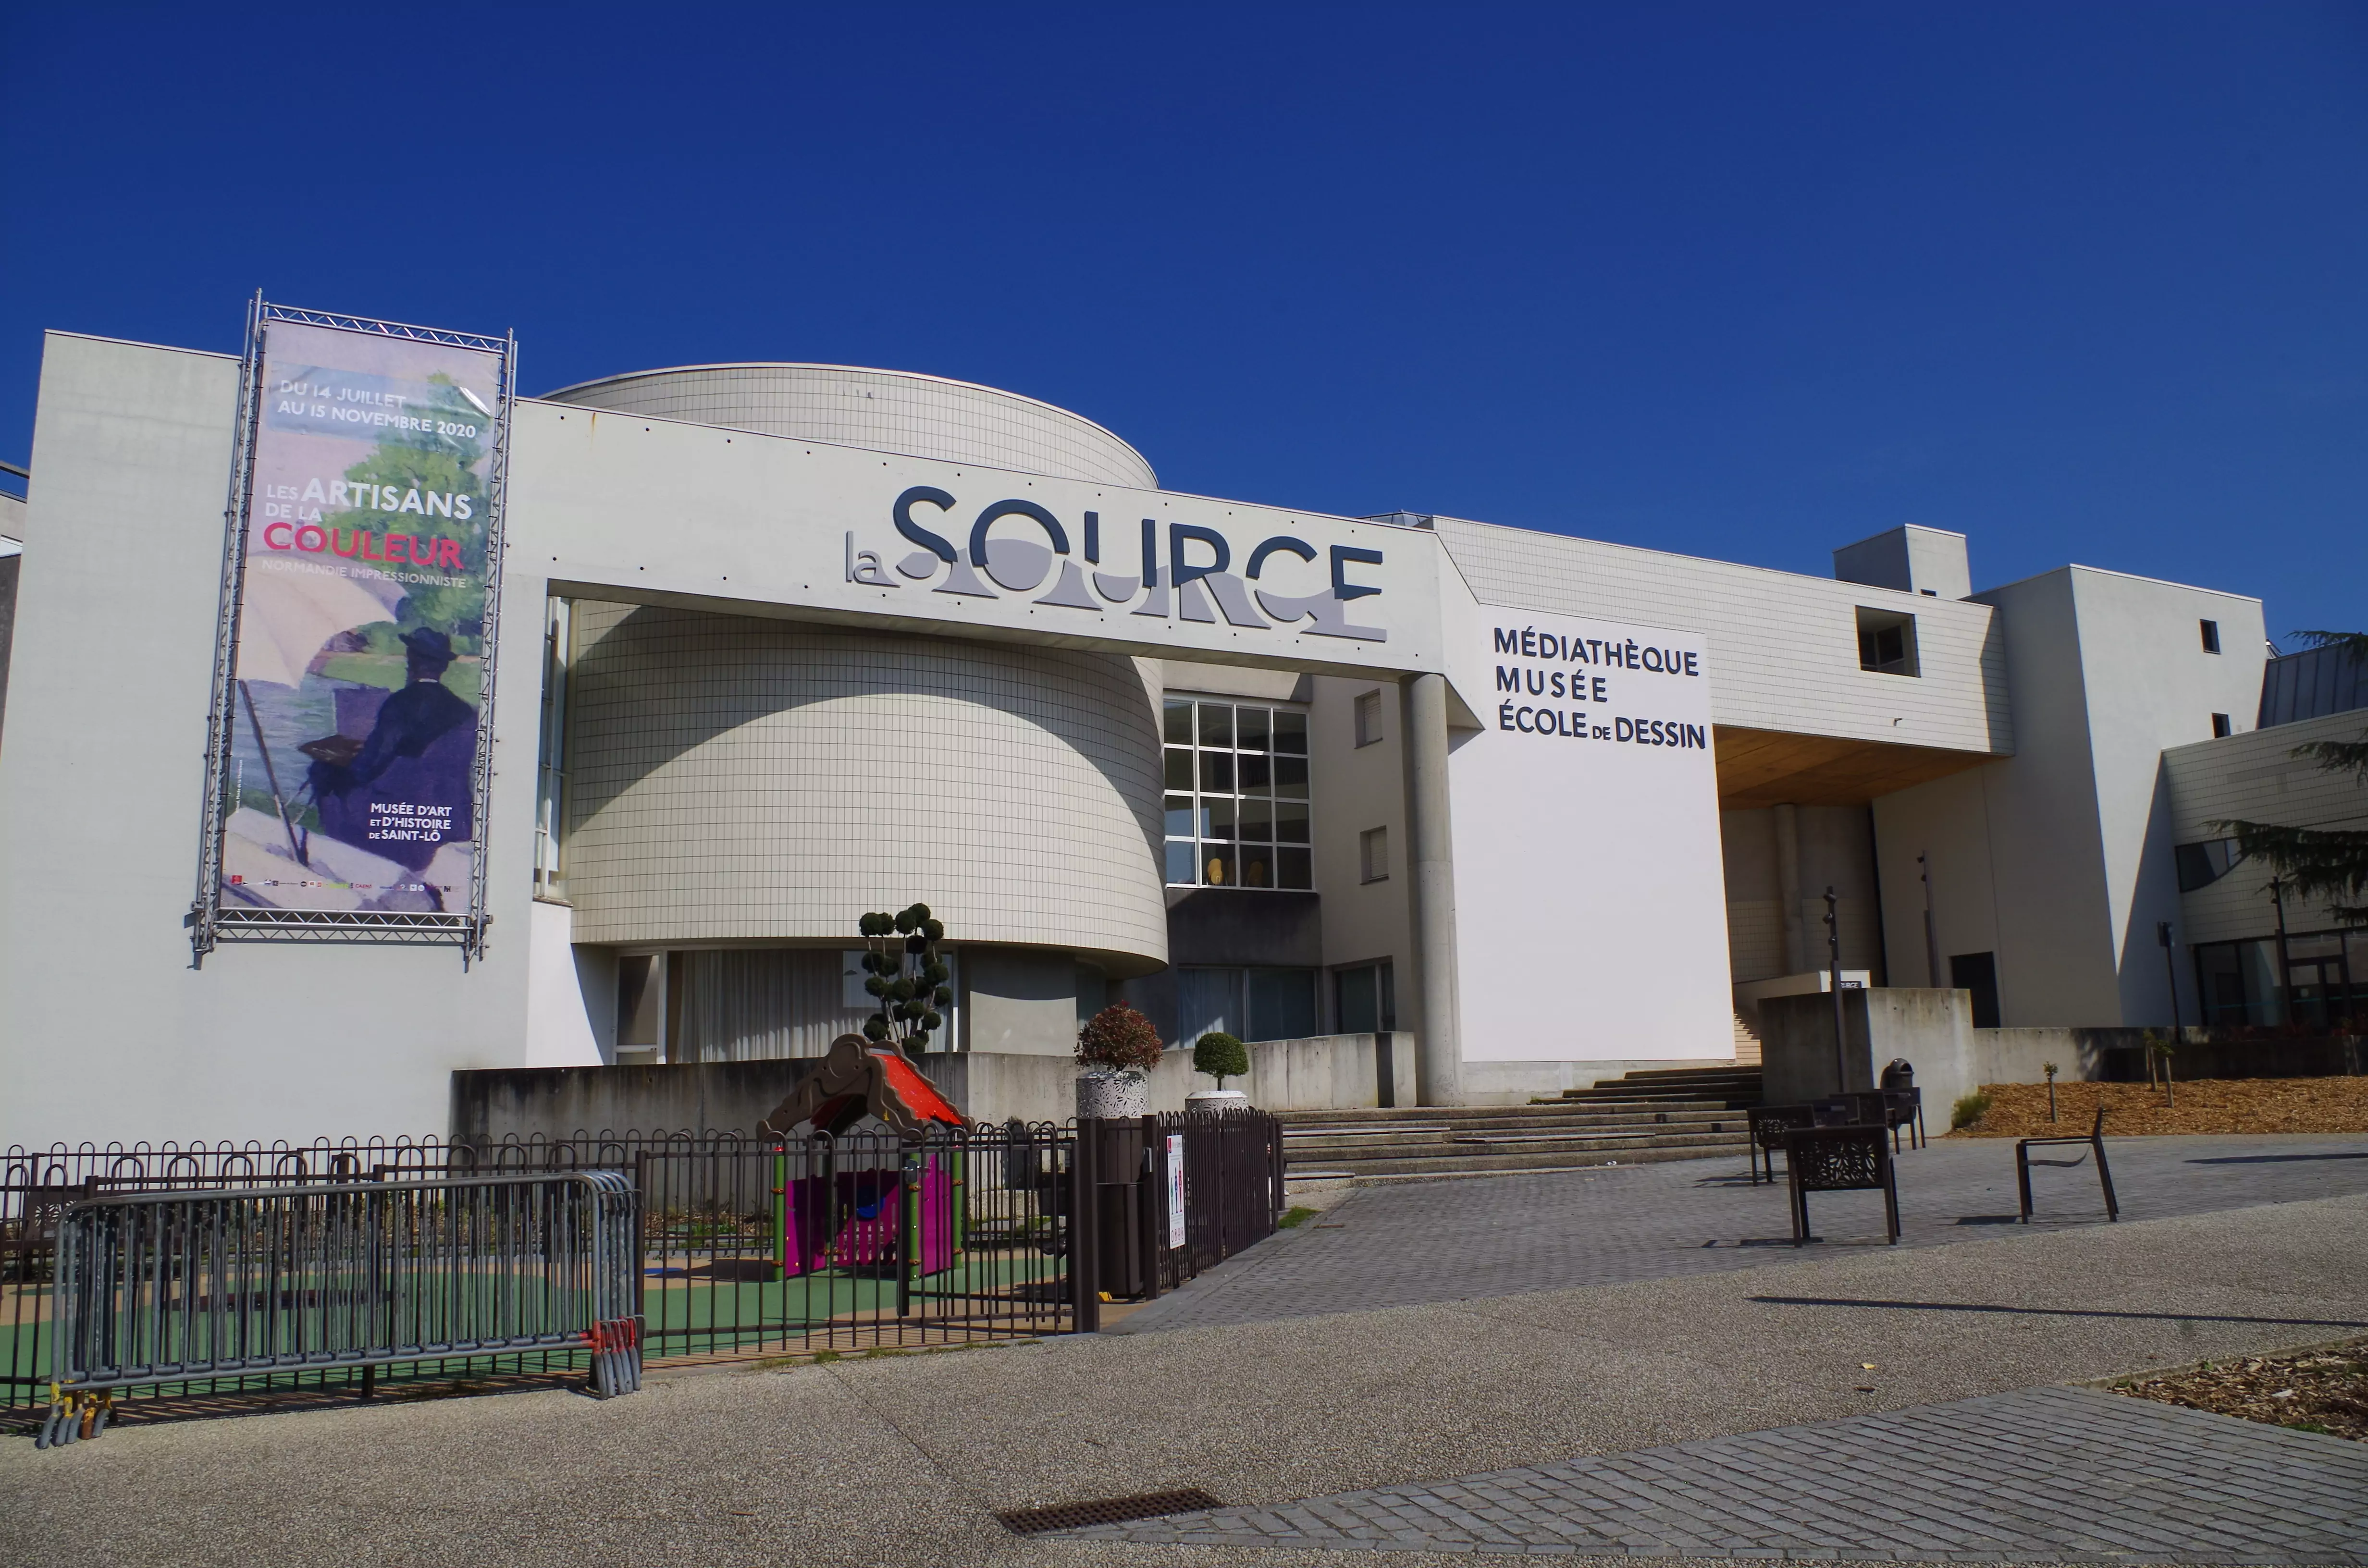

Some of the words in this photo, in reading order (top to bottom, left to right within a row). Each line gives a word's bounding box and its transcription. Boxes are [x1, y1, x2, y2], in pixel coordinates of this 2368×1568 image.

[281, 380, 307, 396] DU
[313, 385, 332, 399] 14
[337, 388, 407, 409] JUILLET
[277, 400, 305, 415] AU
[310, 404, 326, 418] 15
[332, 407, 432, 432] NOVEMBRE
[437, 421, 476, 438] 2020
[265, 502, 292, 518] DE
[298, 506, 322, 522] LA
[267, 484, 298, 501] LES
[300, 478, 473, 520] ARTISANS
[263, 522, 464, 569] COULEUR
[261, 559, 347, 576] NORMANDIE
[351, 567, 467, 588] IMPRESSIONNISTE
[846, 530, 901, 588] la
[893, 486, 1387, 643] SOURCE
[1494, 626, 1699, 676] MÉDIATHÈQUE
[1496, 666, 1607, 702] MUSÉE
[1499, 699, 1588, 738] ÉCOLE
[1592, 725, 1611, 741] DE
[1616, 717, 1705, 749] DESSIN
[371, 802, 414, 815] MUSÉE
[417, 805, 453, 817] D'ART
[382, 817, 451, 830] D'HISTOIRE
[382, 829, 441, 842] SAINT-LÔ
